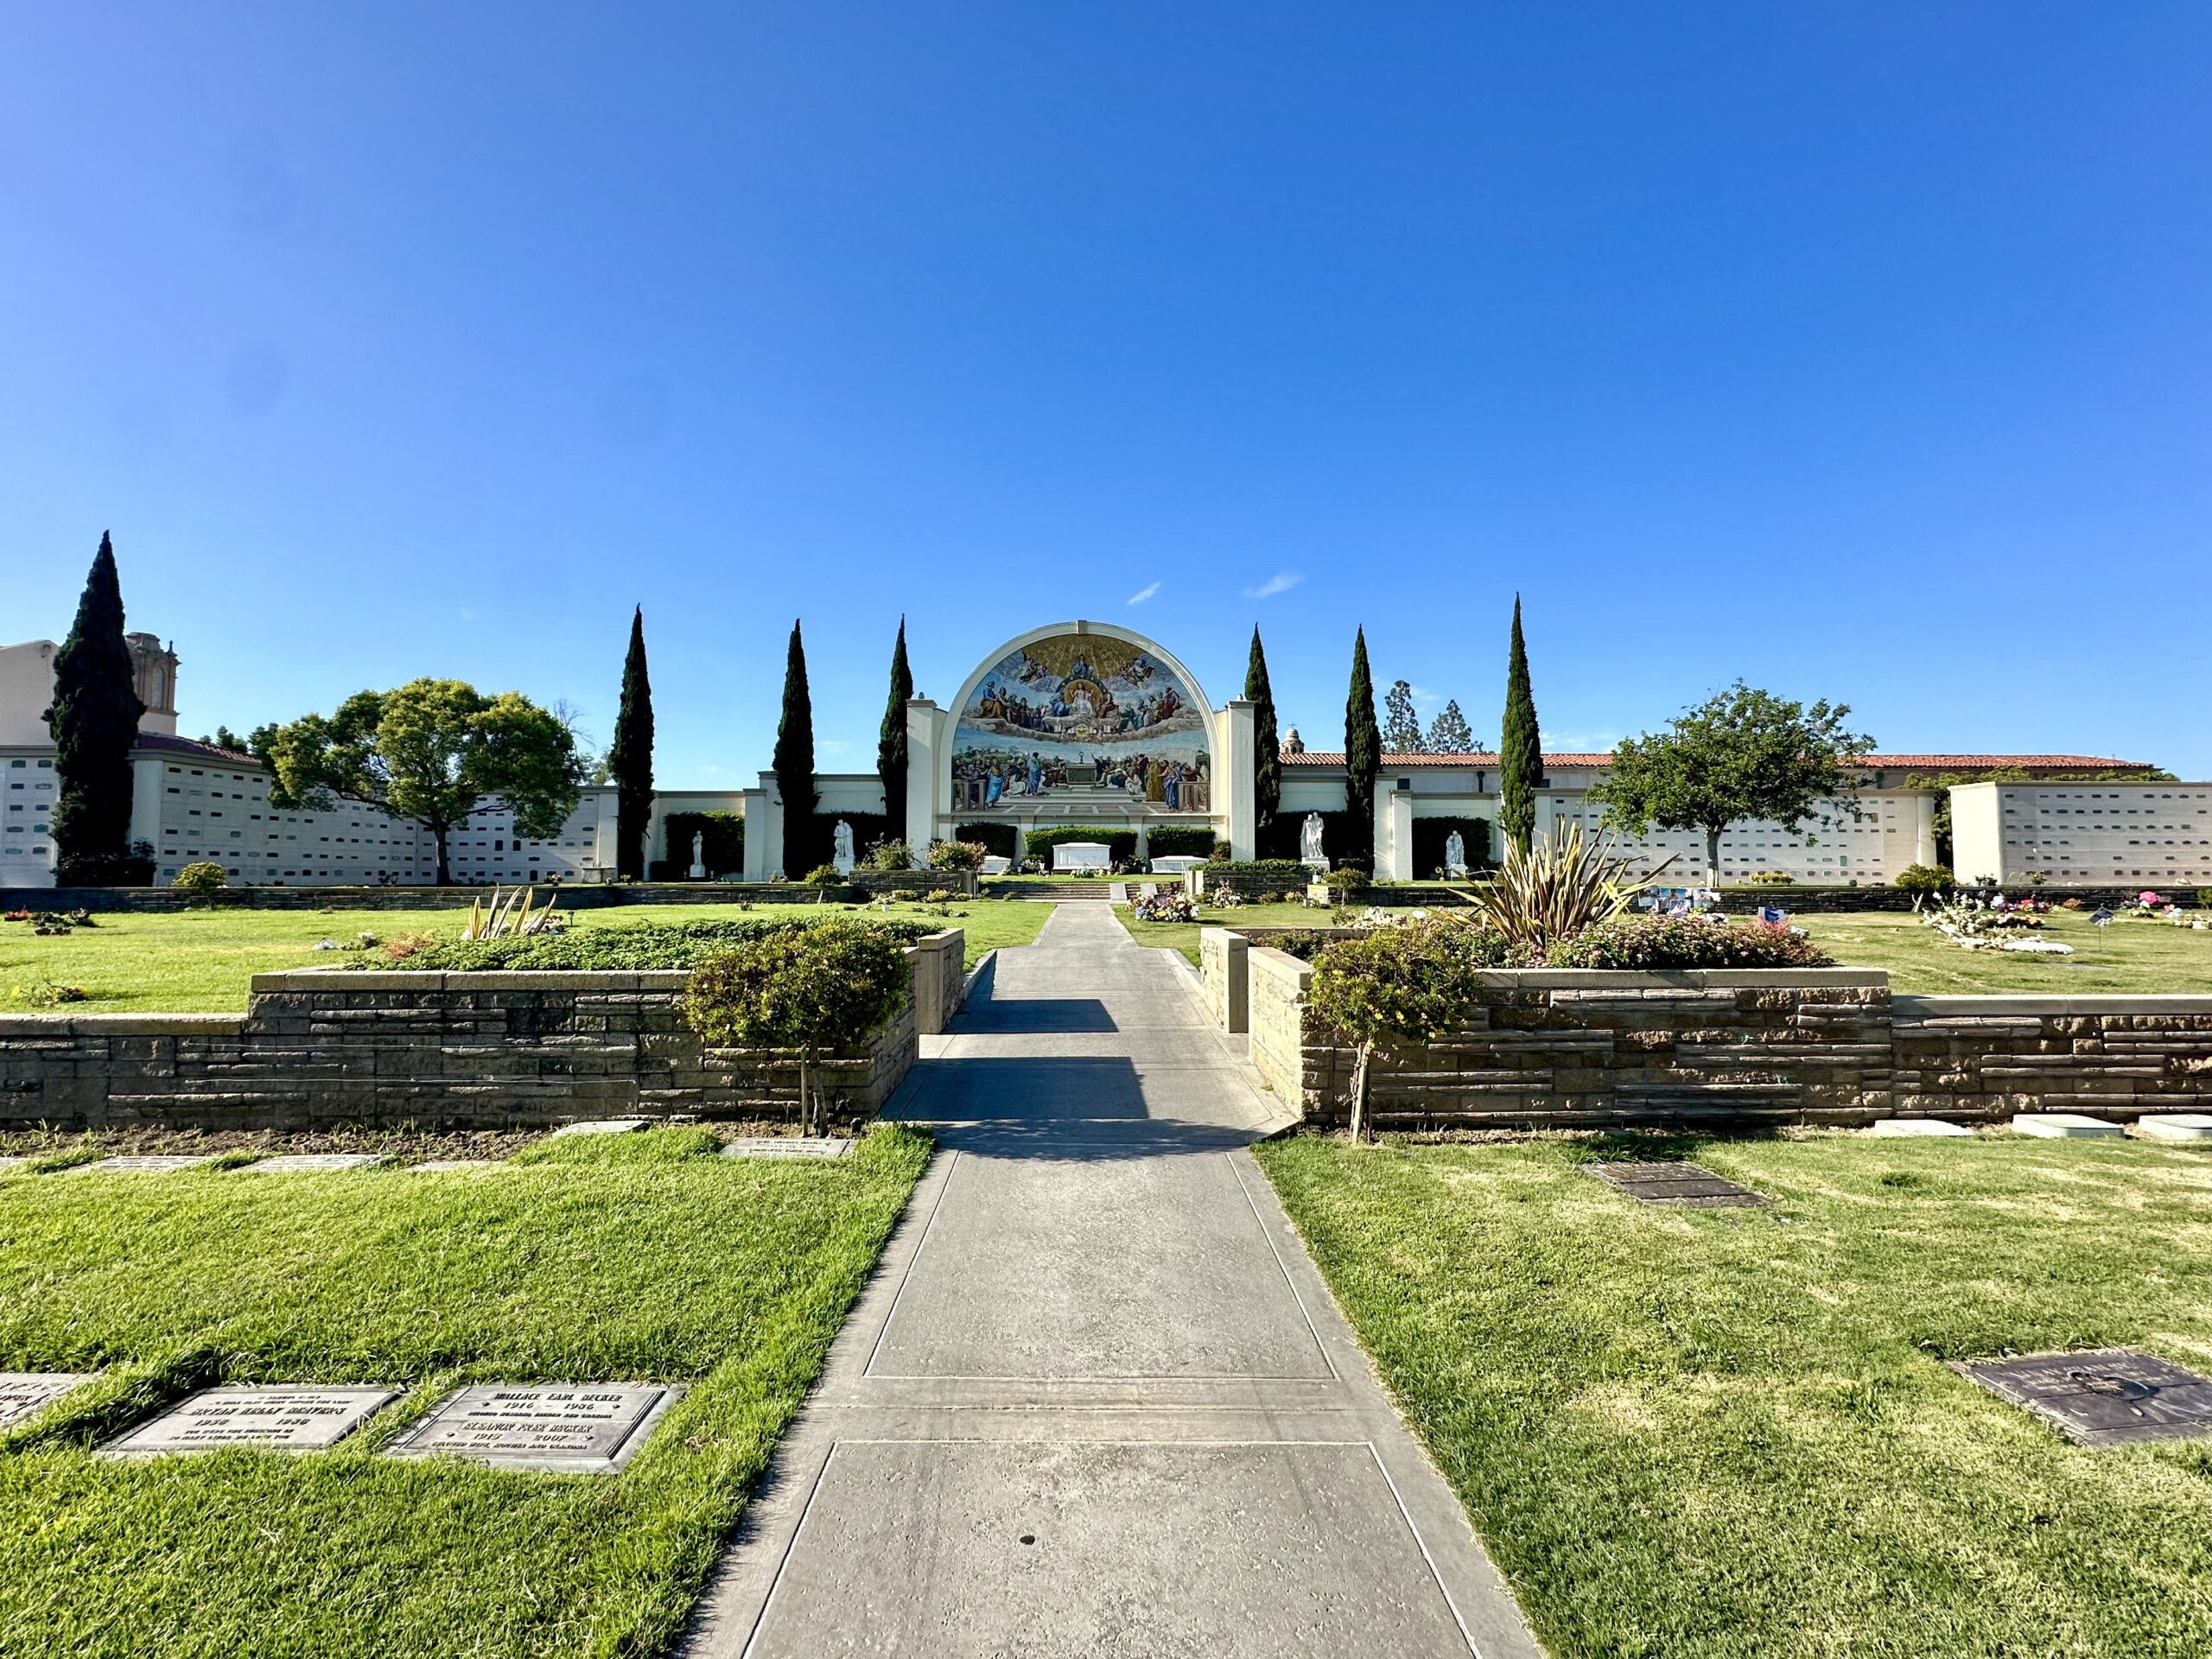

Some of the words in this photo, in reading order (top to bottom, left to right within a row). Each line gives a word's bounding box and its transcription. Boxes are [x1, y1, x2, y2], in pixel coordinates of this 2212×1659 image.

[493, 1392, 543, 1401] WALLACE
[581, 1393, 623, 1402] BECKER
[461, 1422, 516, 1432] ELEANOR
[548, 1424, 594, 1433] BECKER
